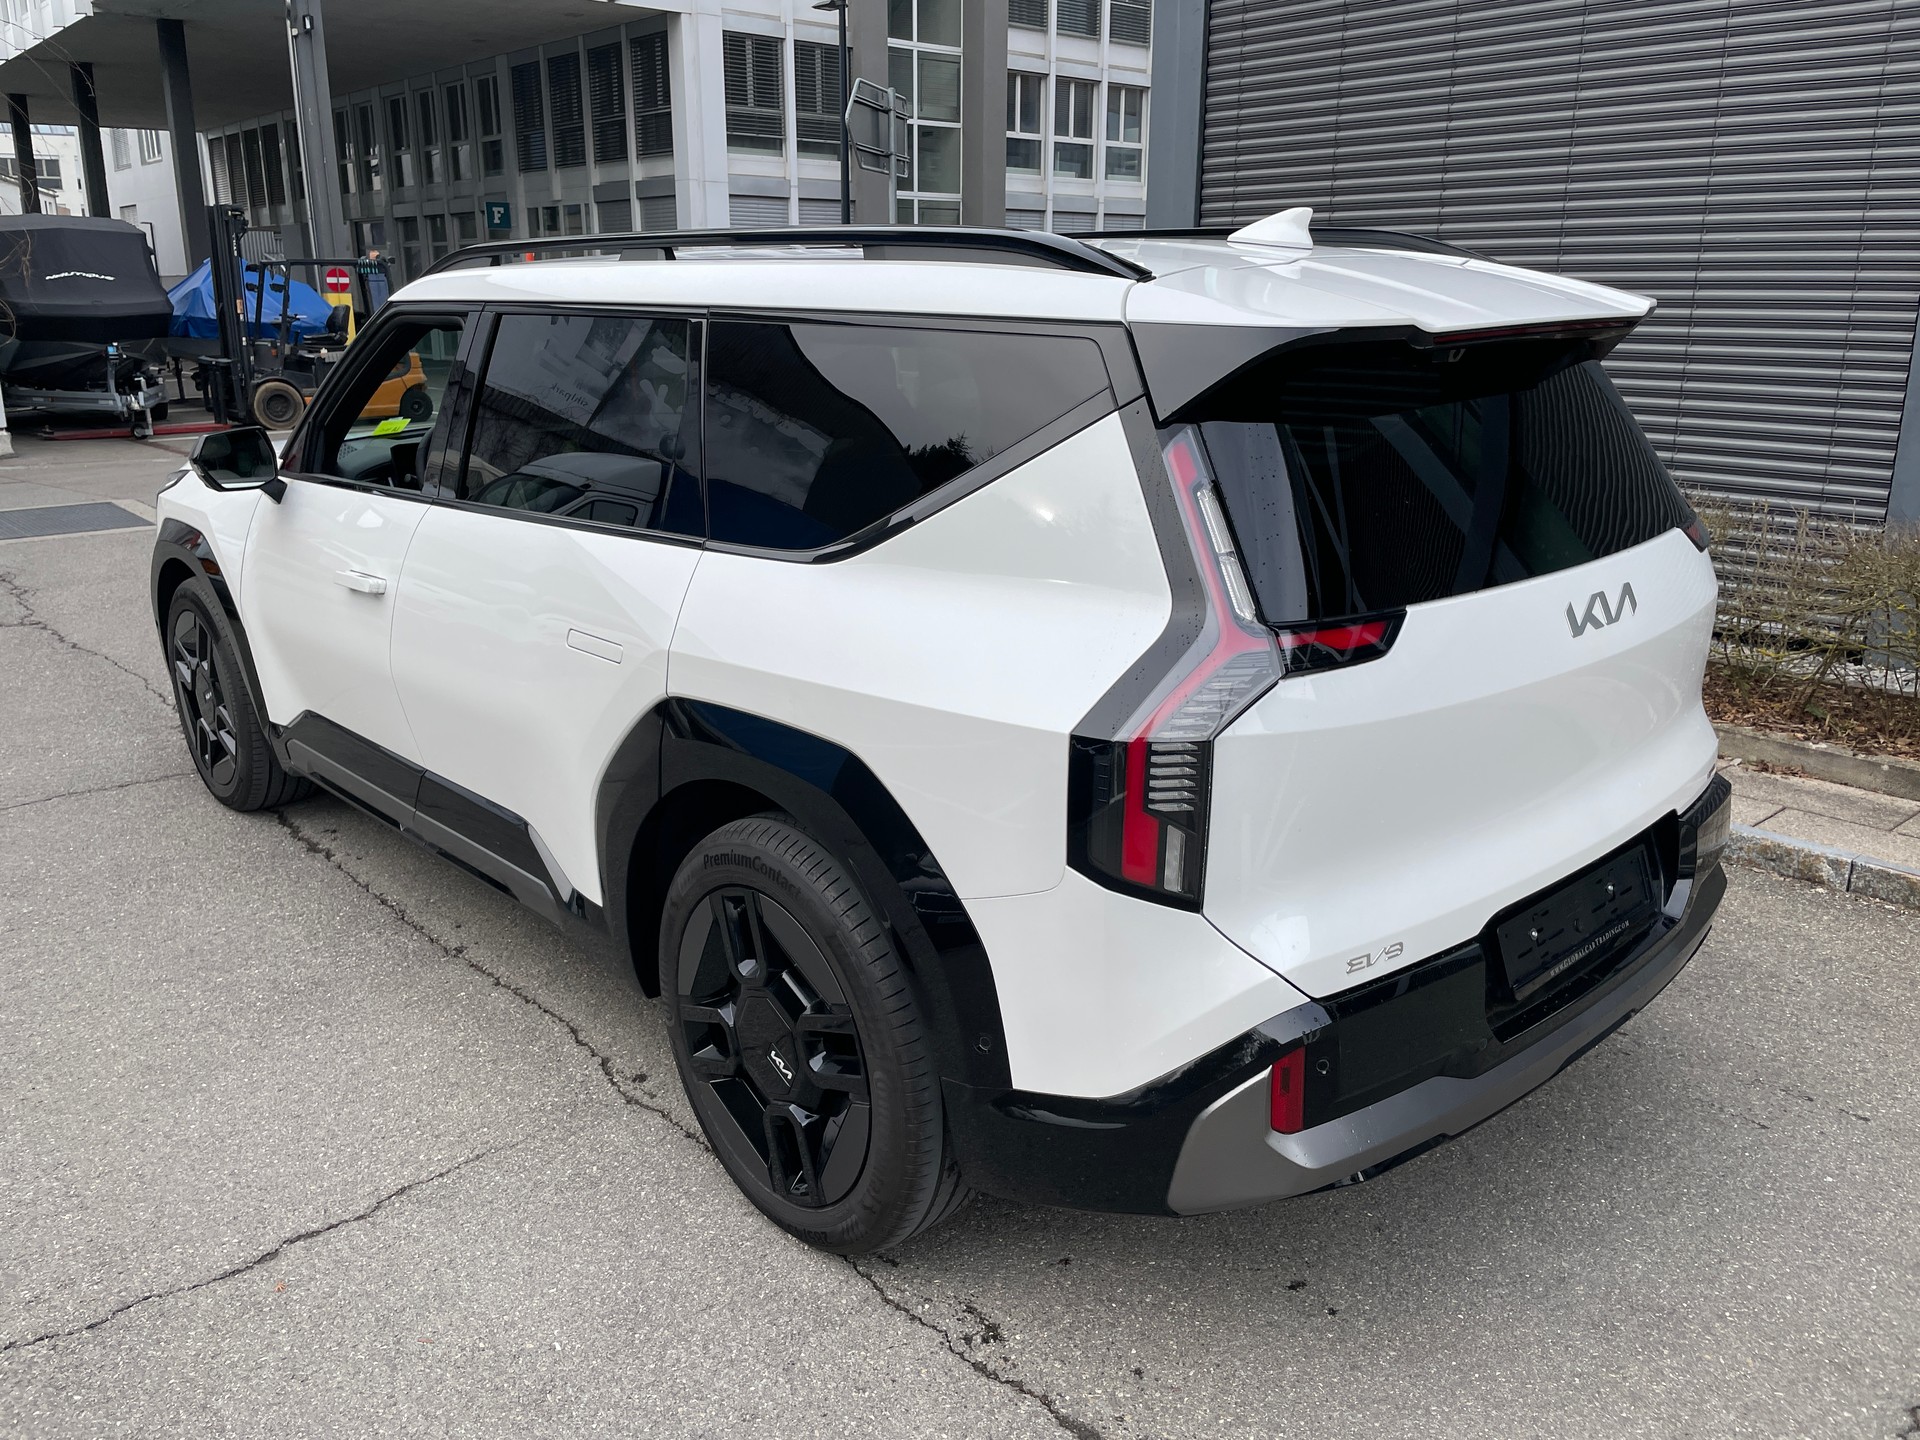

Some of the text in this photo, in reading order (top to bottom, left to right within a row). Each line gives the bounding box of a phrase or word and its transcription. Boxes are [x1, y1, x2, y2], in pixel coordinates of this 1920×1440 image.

[492, 206, 505, 224] F
[1564, 581, 1638, 639] KIA
[1346, 941, 1404, 975] EV9
